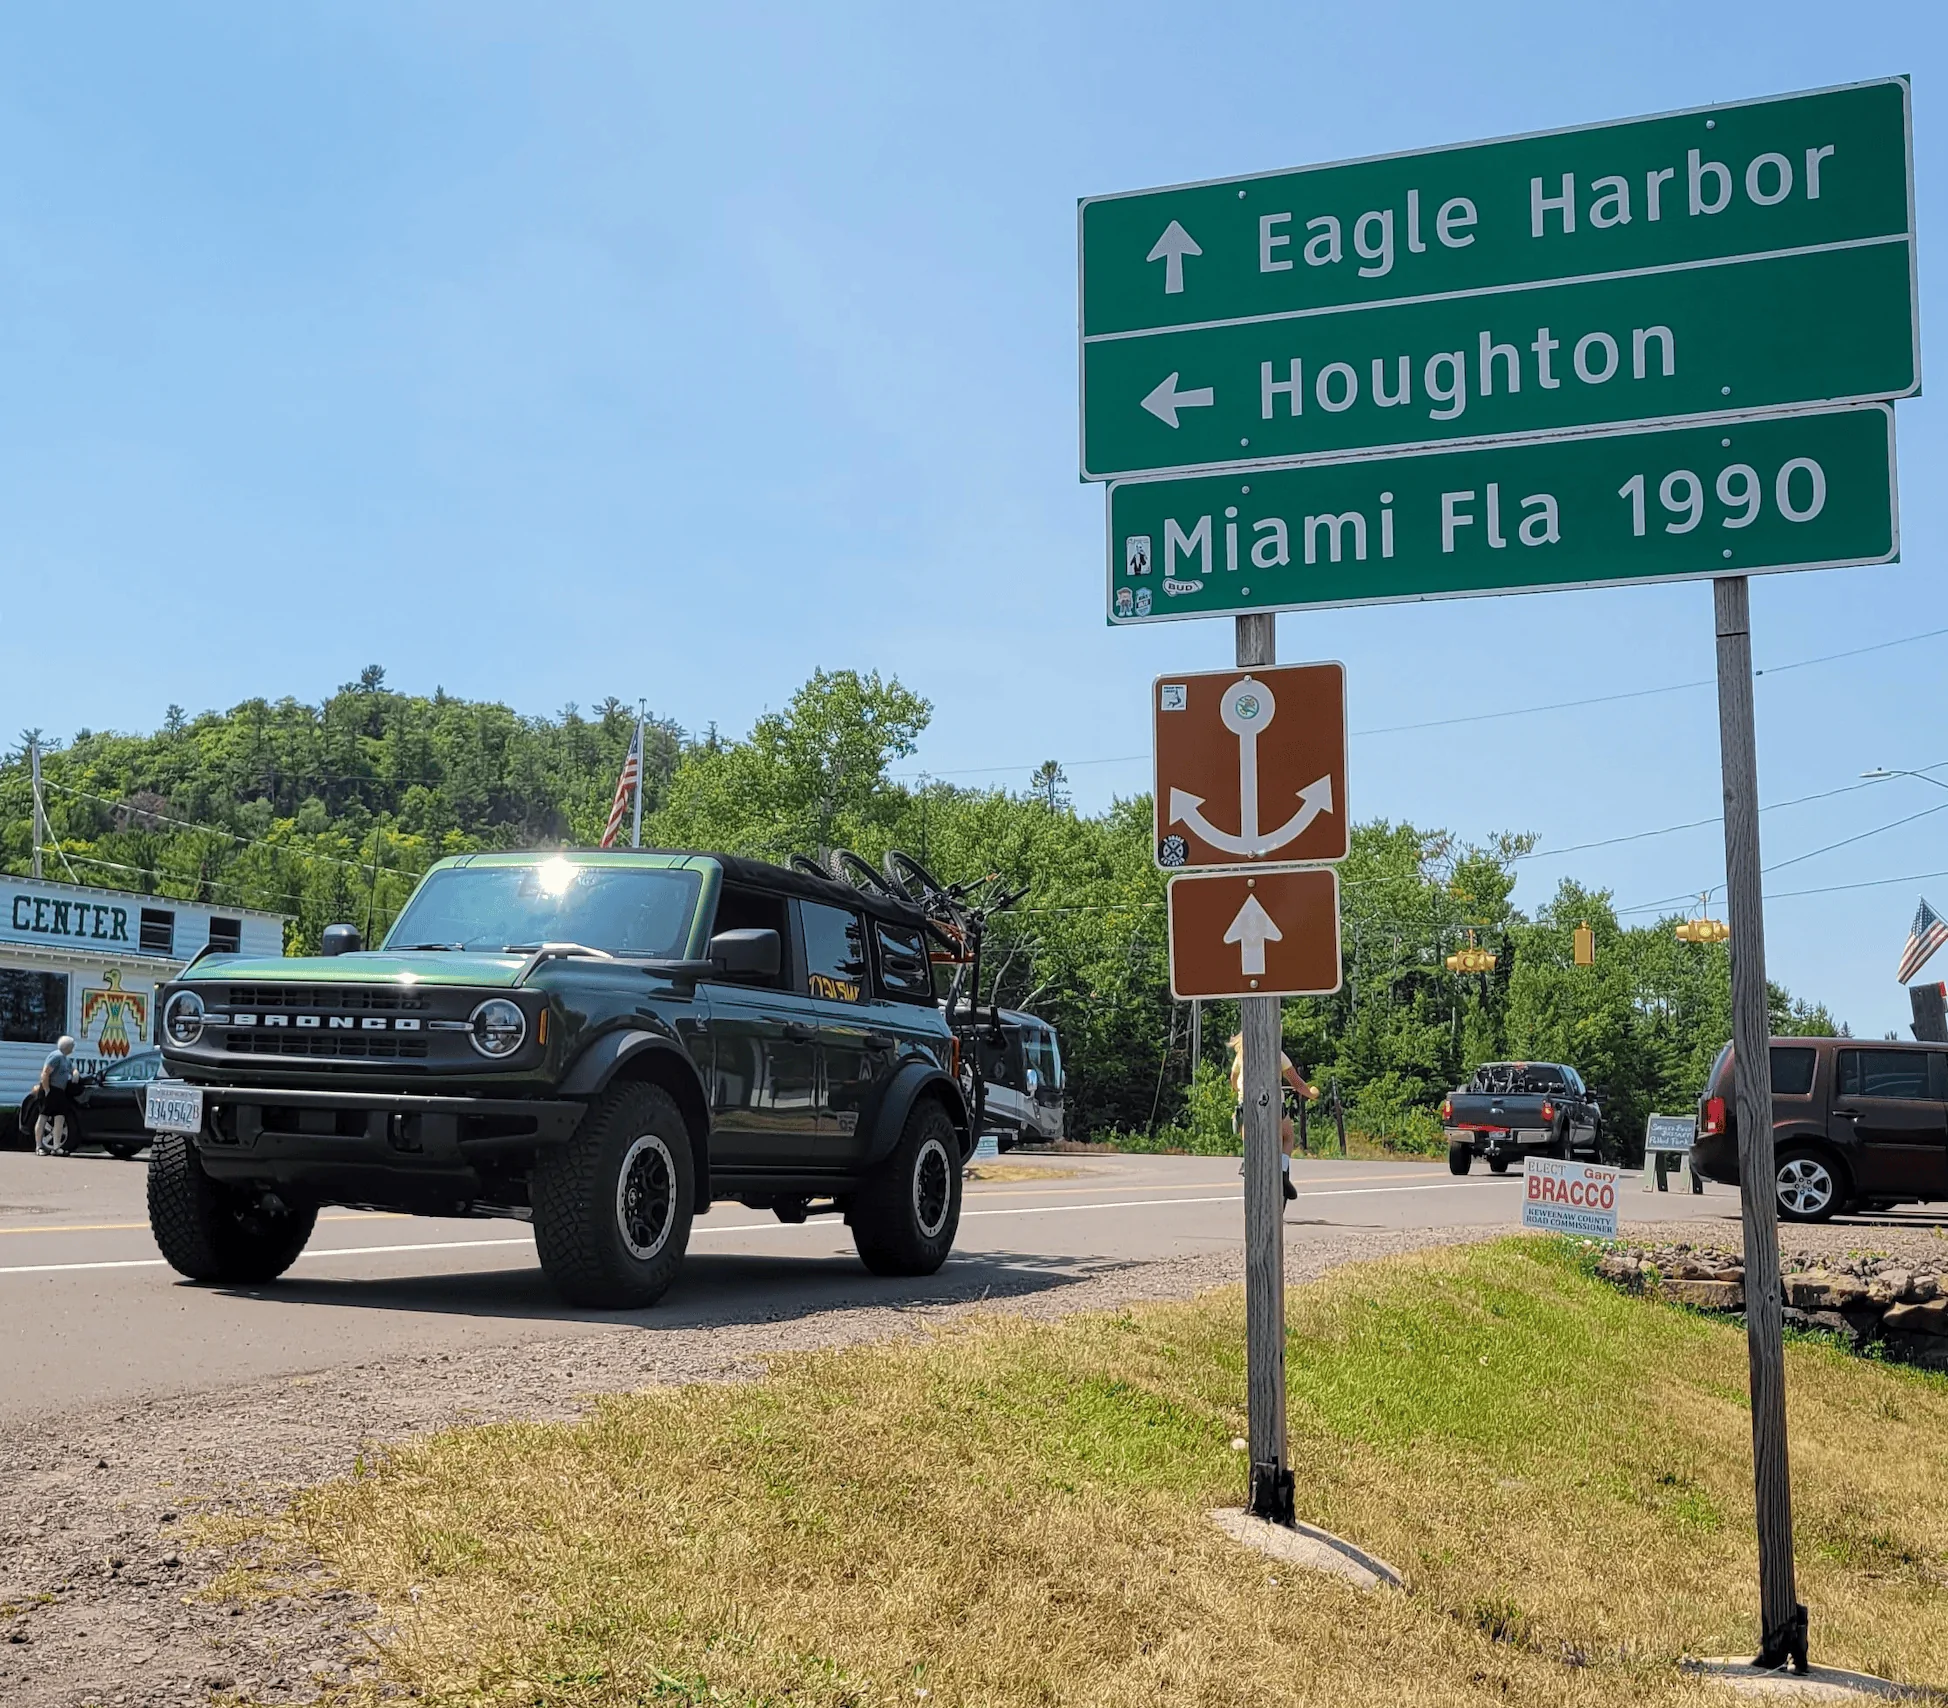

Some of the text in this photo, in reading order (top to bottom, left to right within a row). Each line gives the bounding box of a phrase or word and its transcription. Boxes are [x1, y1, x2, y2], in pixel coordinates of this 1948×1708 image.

[1259, 144, 1835, 278] Eagle Harbor
[1260, 325, 1675, 421] Houghton
[1163, 457, 1827, 577] Miami Fla 1990
[1168, 582, 1194, 592] BUD
[12, 895, 129, 941] CENTER
[234, 1014, 420, 1030] BRONCO
[1528, 1161, 1567, 1175] ELECT
[1584, 1168, 1616, 1184] Gary
[1528, 1175, 1615, 1210] BRACCO
[1526, 1215, 1613, 1234] ROAD COMMISSIONER
[1528, 1207, 1577, 1221] KEWEENAW
[1577, 1214, 1611, 1226] COUNTY
